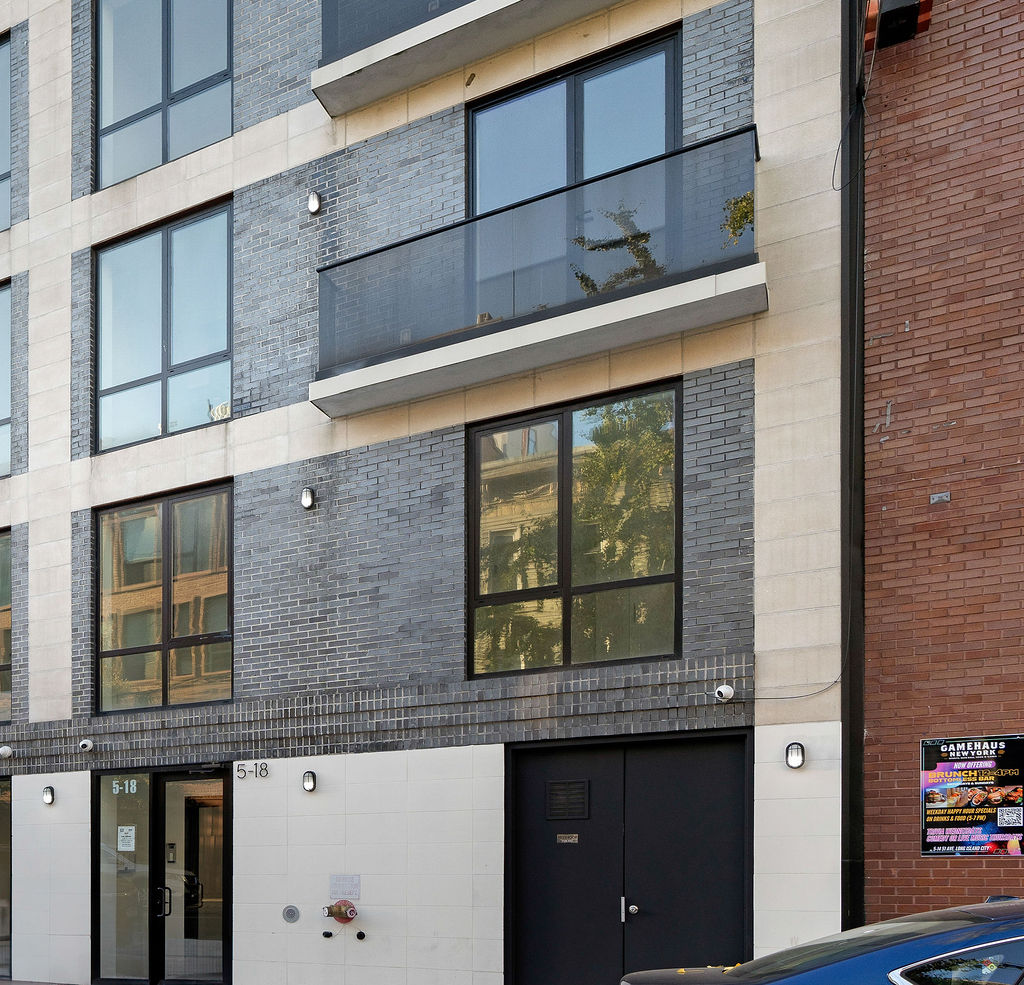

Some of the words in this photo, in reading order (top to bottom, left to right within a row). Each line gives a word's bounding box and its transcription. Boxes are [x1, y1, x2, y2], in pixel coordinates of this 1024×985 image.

[940, 742, 1006, 752] GAMEHAUS
[236, 762, 269, 779] 5-18
[966, 761, 993, 769] OFFERING
[112, 779, 138, 795] 5-18
